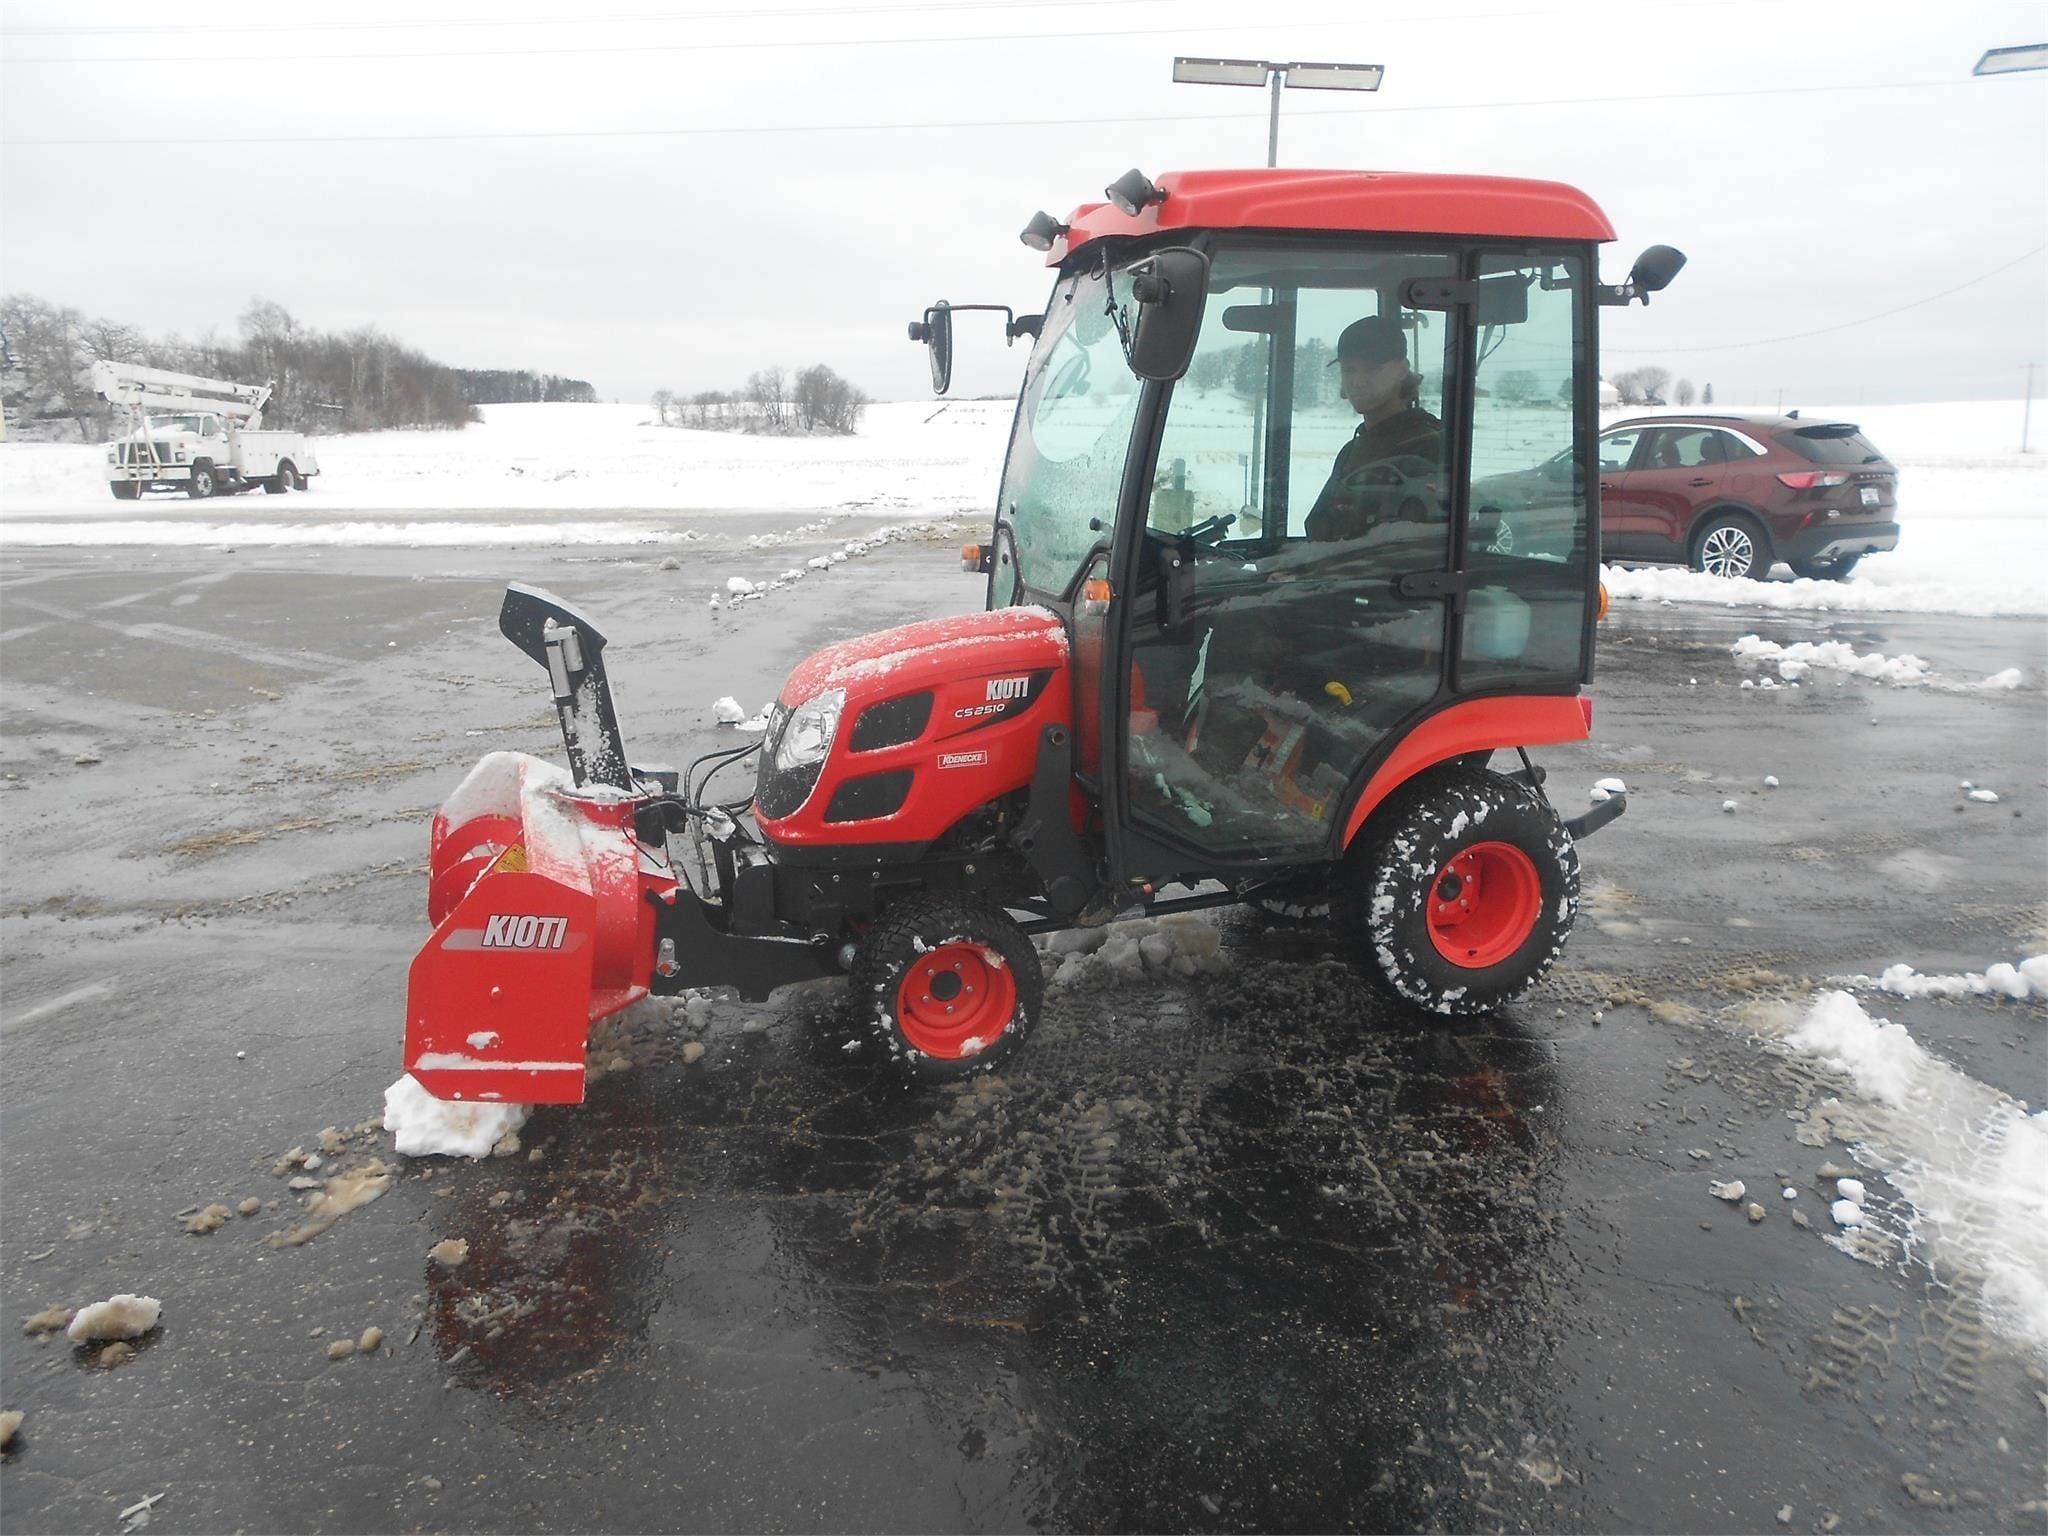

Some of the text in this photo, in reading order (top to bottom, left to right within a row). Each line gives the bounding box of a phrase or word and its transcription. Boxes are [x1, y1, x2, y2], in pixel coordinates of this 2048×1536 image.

[986, 677, 1029, 701] KIOTI
[954, 703, 1005, 718] CS2510
[481, 914, 568, 949] KIOTI
